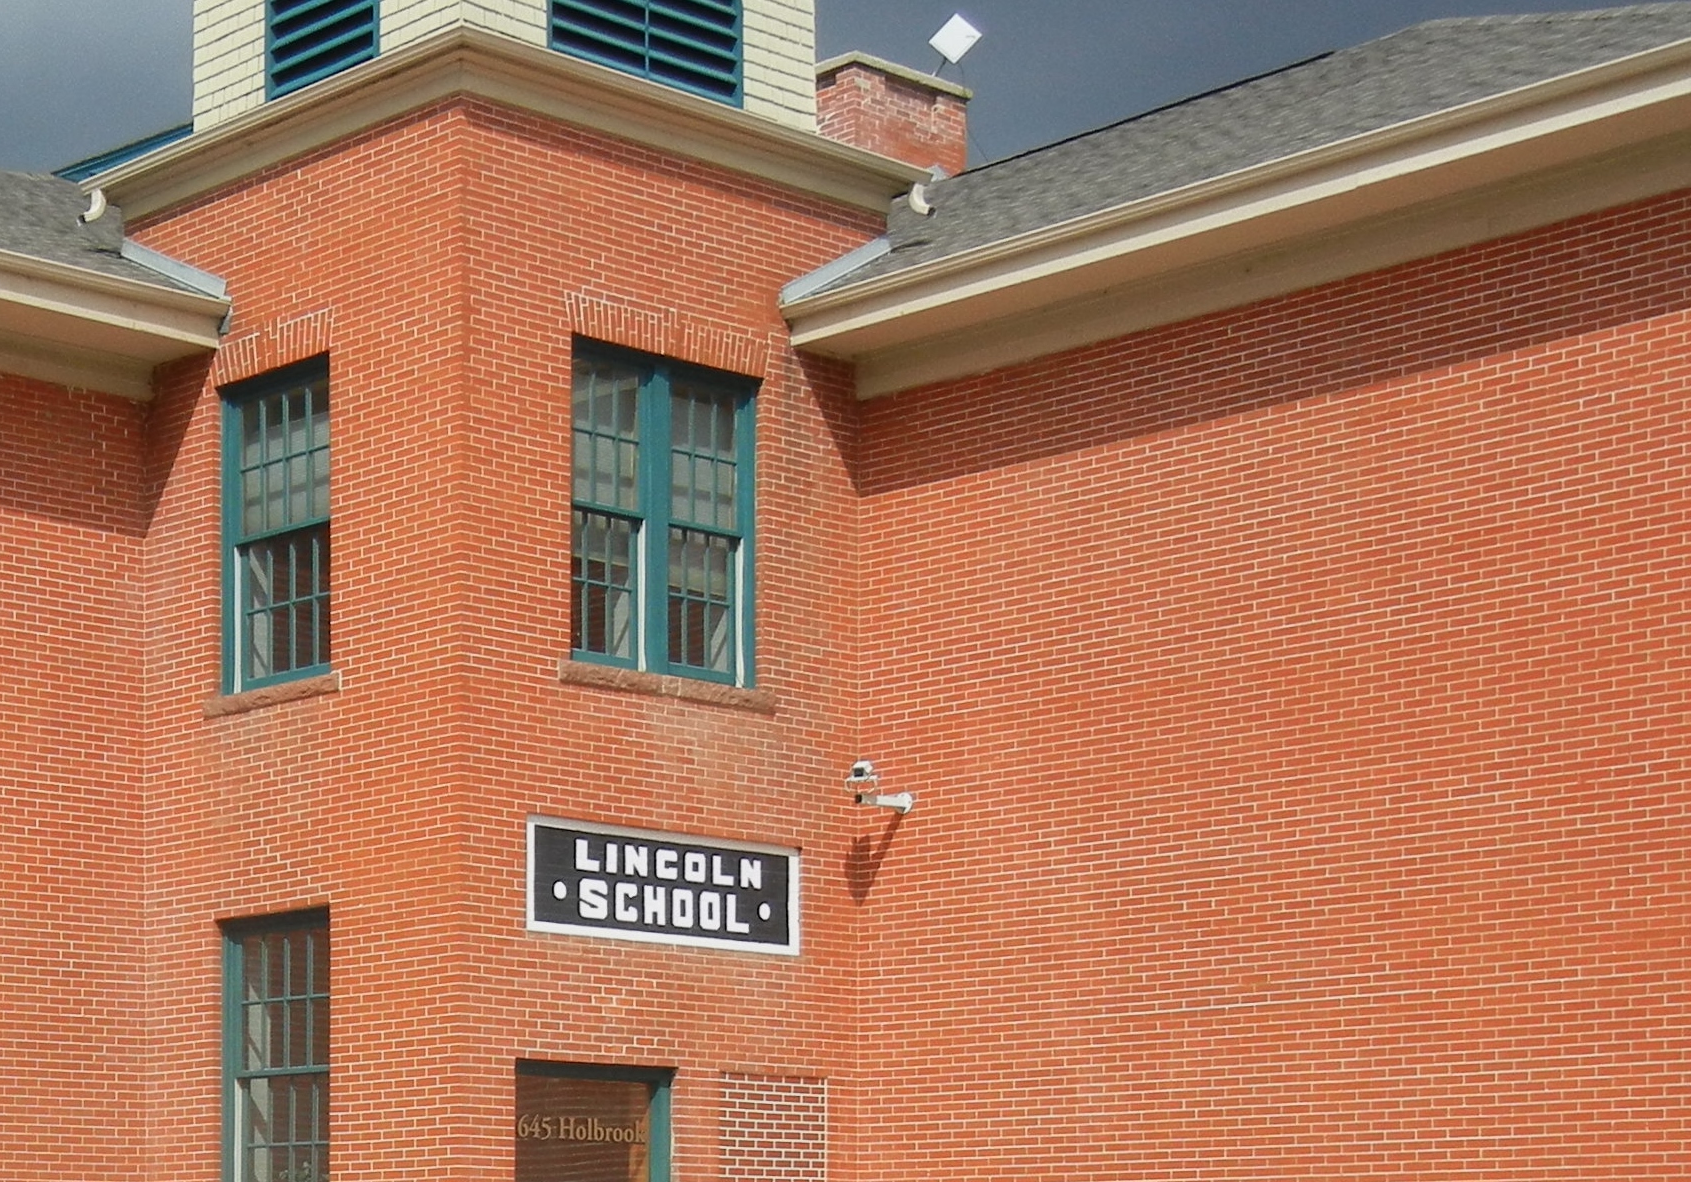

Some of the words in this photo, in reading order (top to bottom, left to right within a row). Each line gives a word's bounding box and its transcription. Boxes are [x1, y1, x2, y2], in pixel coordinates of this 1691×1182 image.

[575, 838, 762, 890] LINCOLN
[579, 878, 750, 934] SCHOOL
[517, 1114, 552, 1141] 645
[559, 1116, 646, 1143] Holbrook
